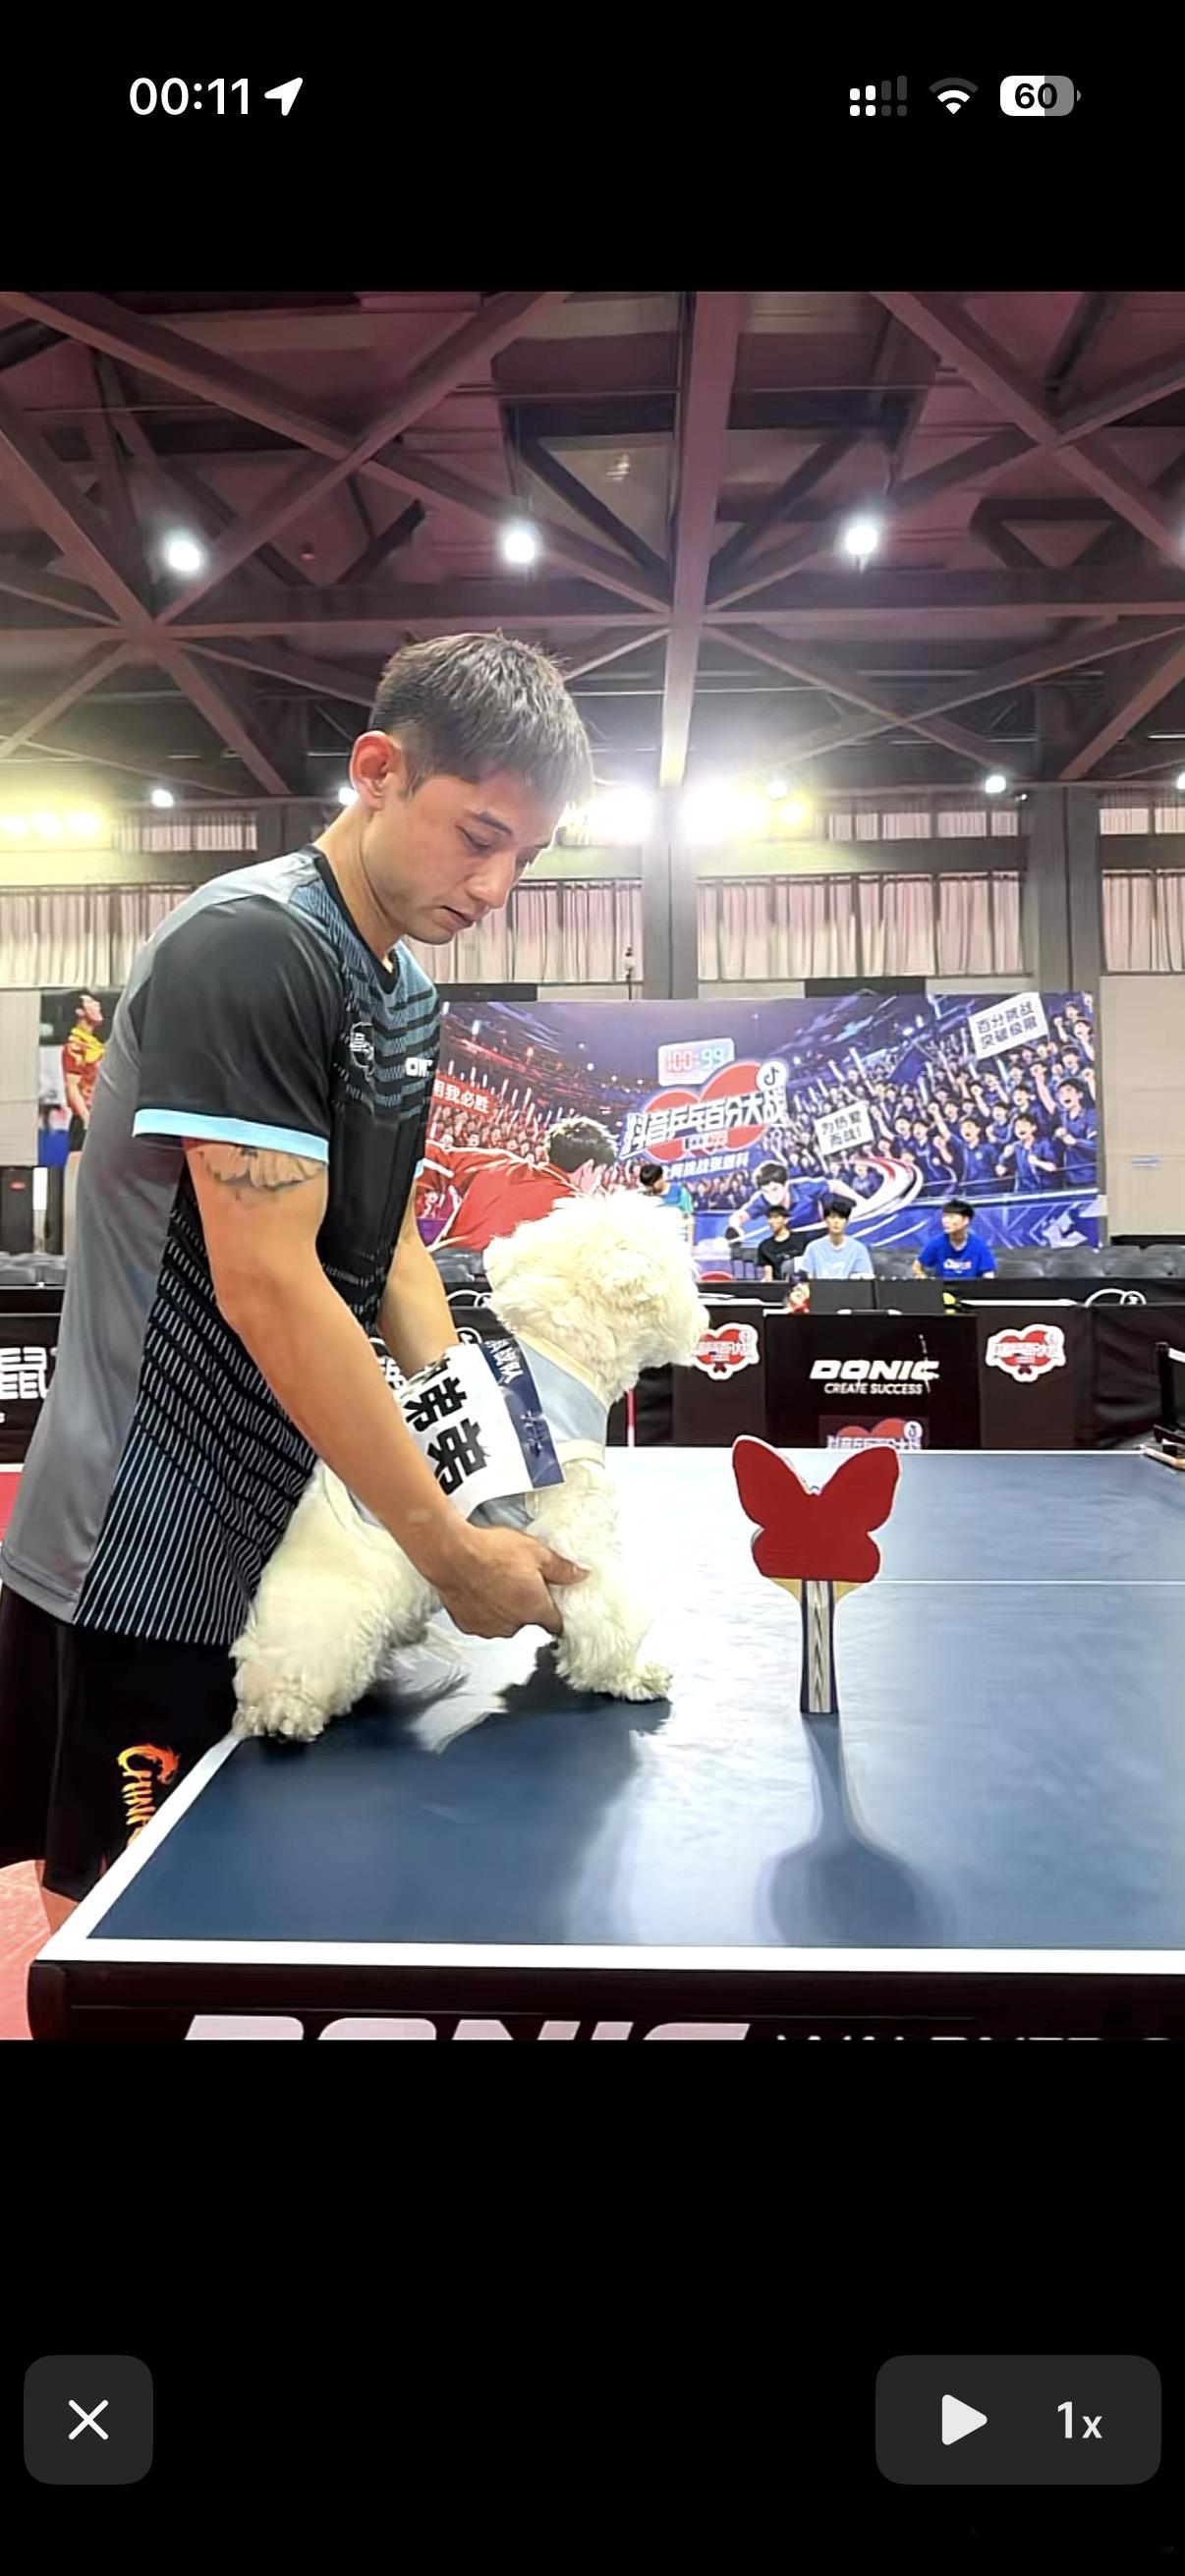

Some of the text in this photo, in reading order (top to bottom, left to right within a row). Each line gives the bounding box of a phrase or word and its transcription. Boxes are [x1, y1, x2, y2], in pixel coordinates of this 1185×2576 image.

[810, 1360, 939, 1380] DONIC
[823, 1382, 924, 1395] CREATE SUCCESS
